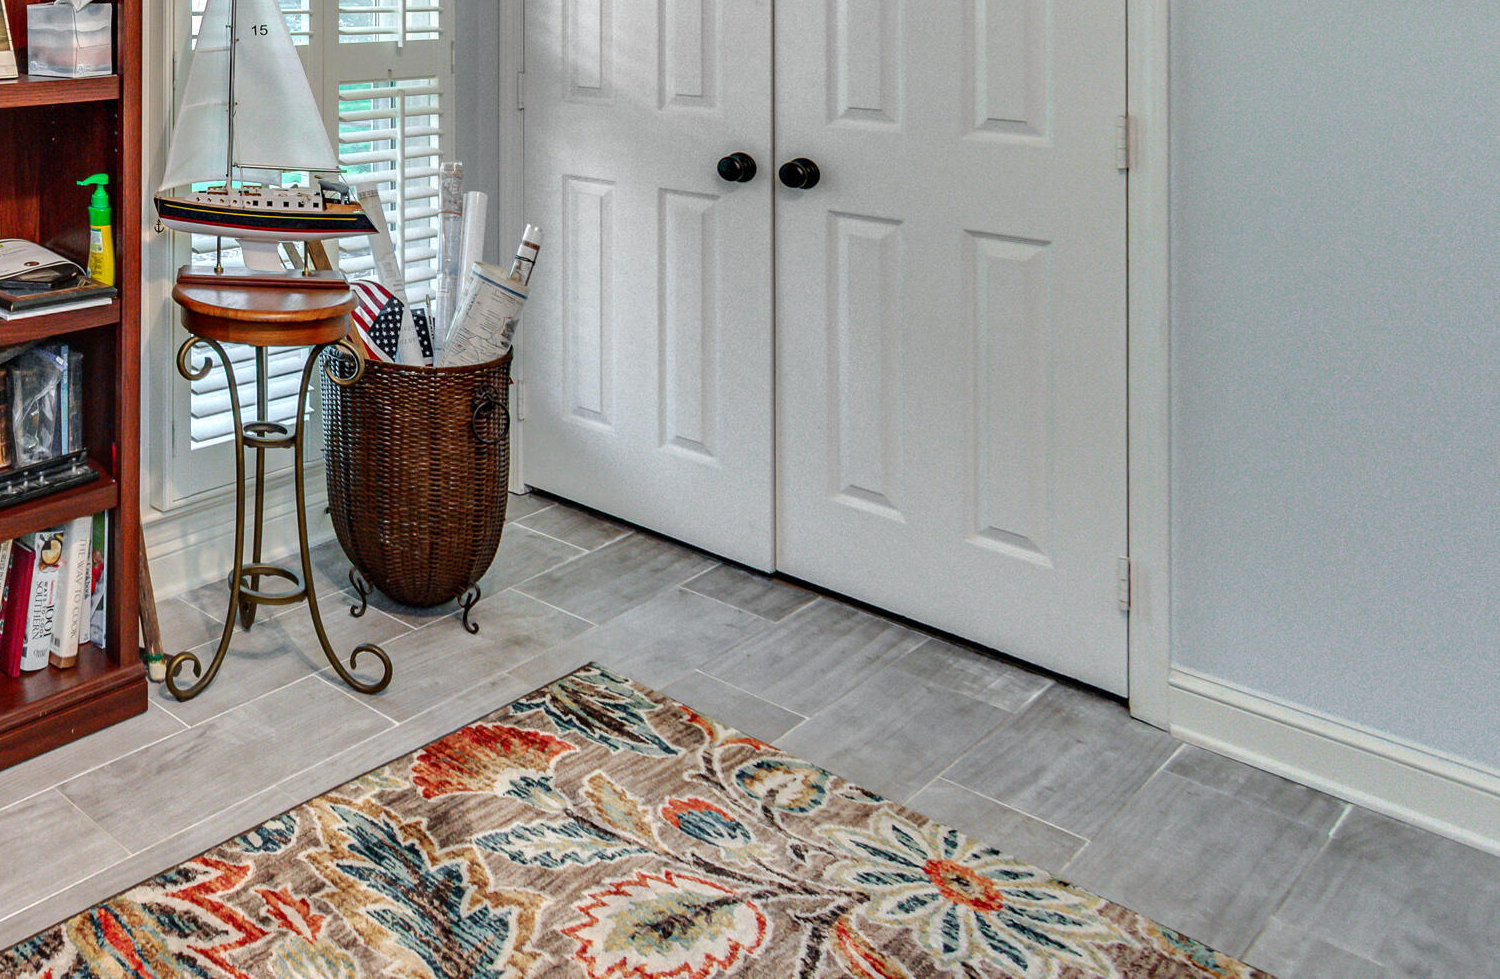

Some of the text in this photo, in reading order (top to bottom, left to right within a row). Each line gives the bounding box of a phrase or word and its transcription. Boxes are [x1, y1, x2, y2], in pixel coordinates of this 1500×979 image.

[251, 24, 269, 37] 15
[32, 581, 43, 640] SOUTHERN
[70, 538, 87, 638] THE WAY TO COOK
